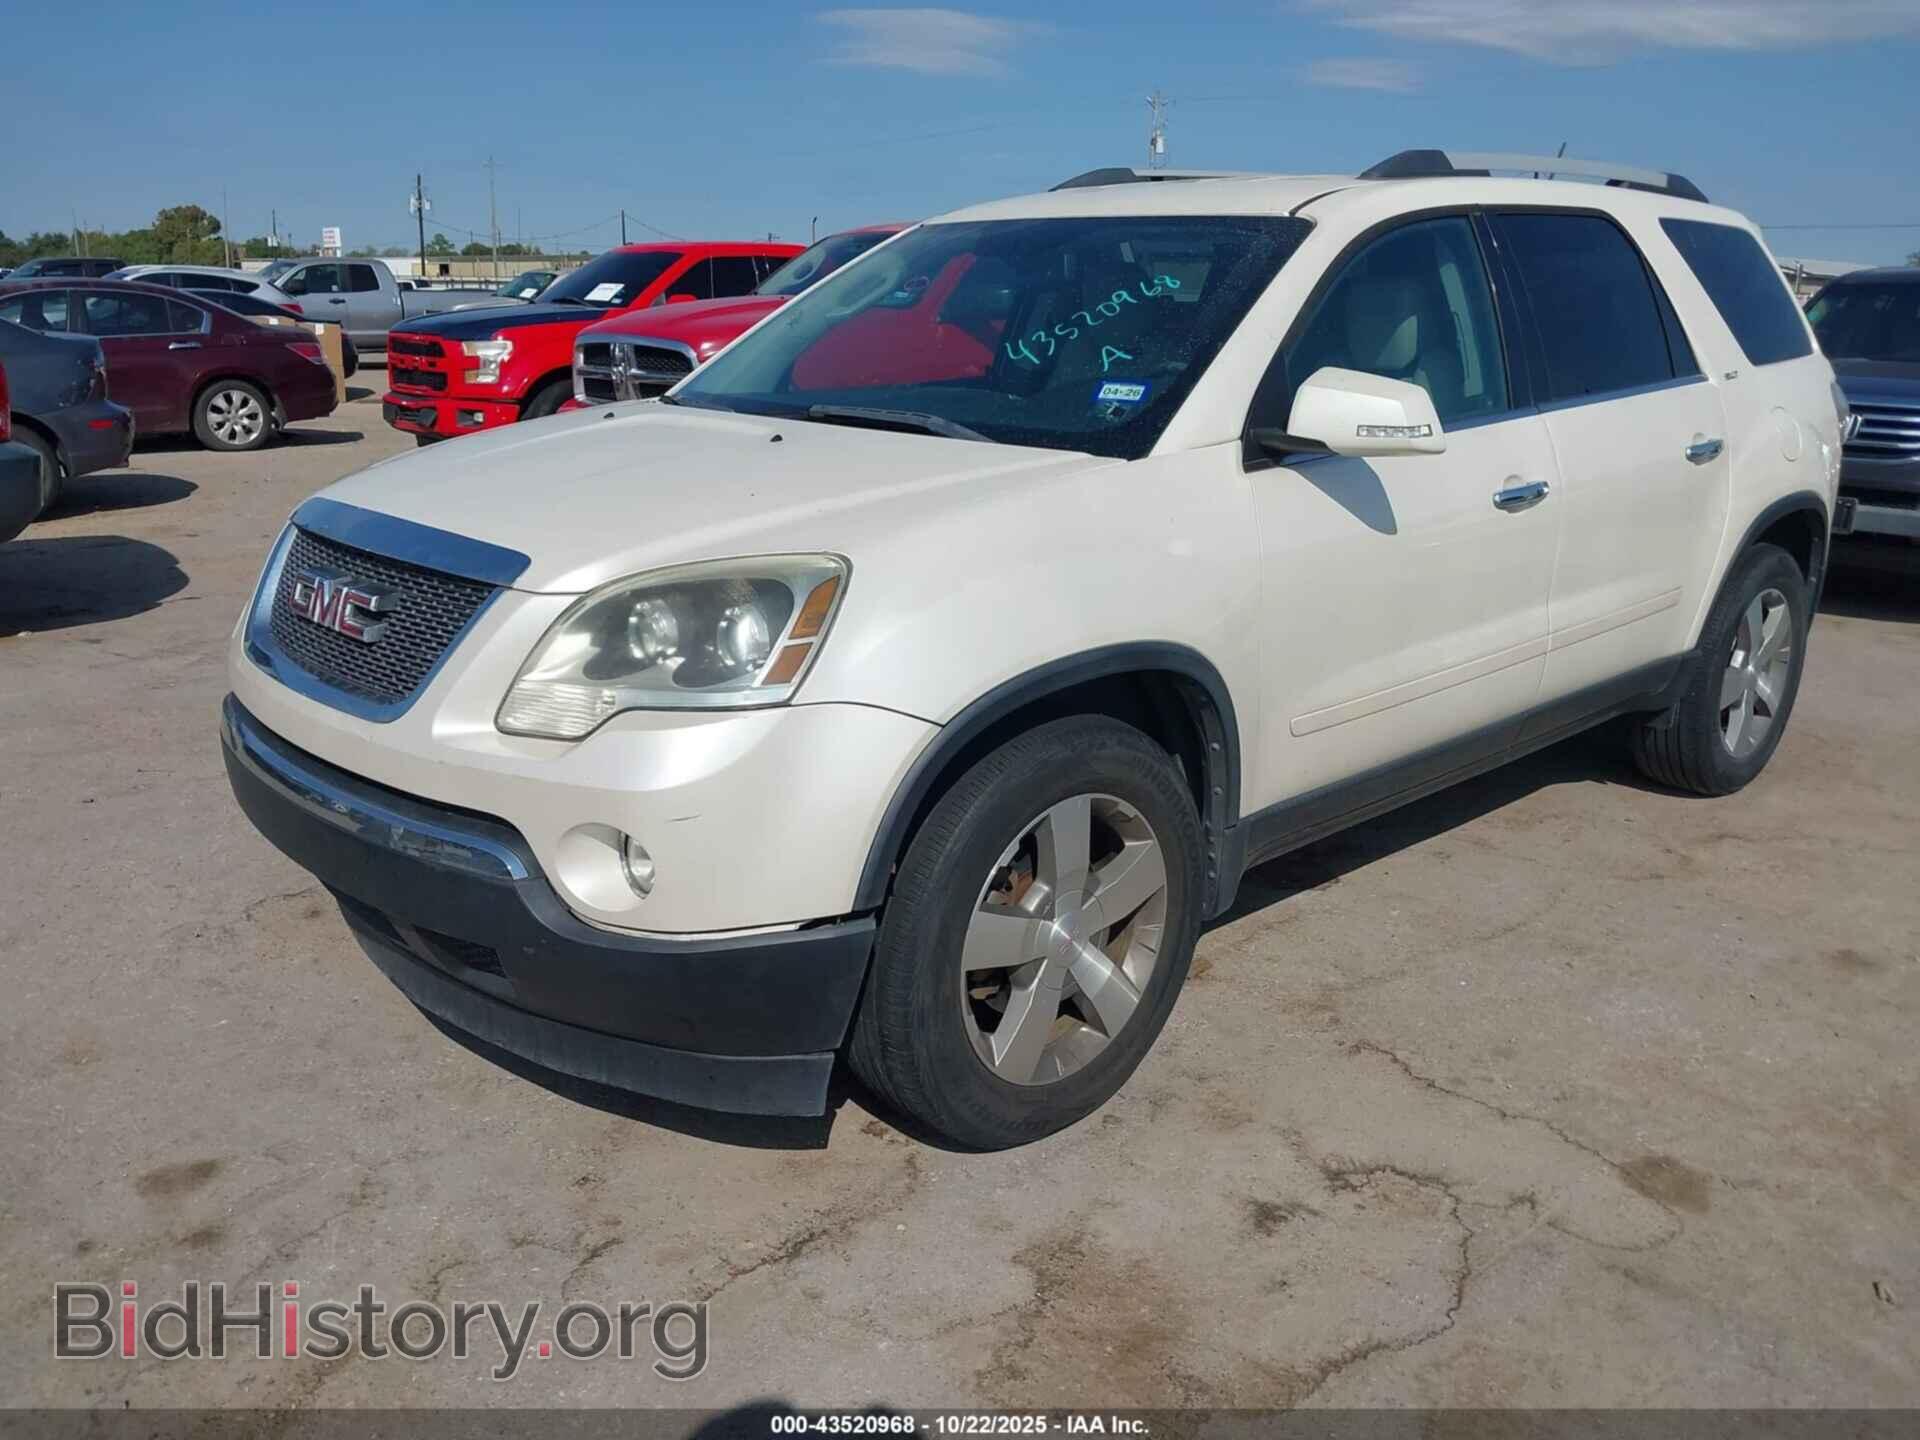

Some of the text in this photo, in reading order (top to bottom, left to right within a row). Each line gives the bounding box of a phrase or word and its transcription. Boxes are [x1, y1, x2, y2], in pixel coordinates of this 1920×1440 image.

[1006, 275, 1181, 364] 43520968
[1101, 345, 1133, 372] A
[288, 569, 398, 643] GMC
